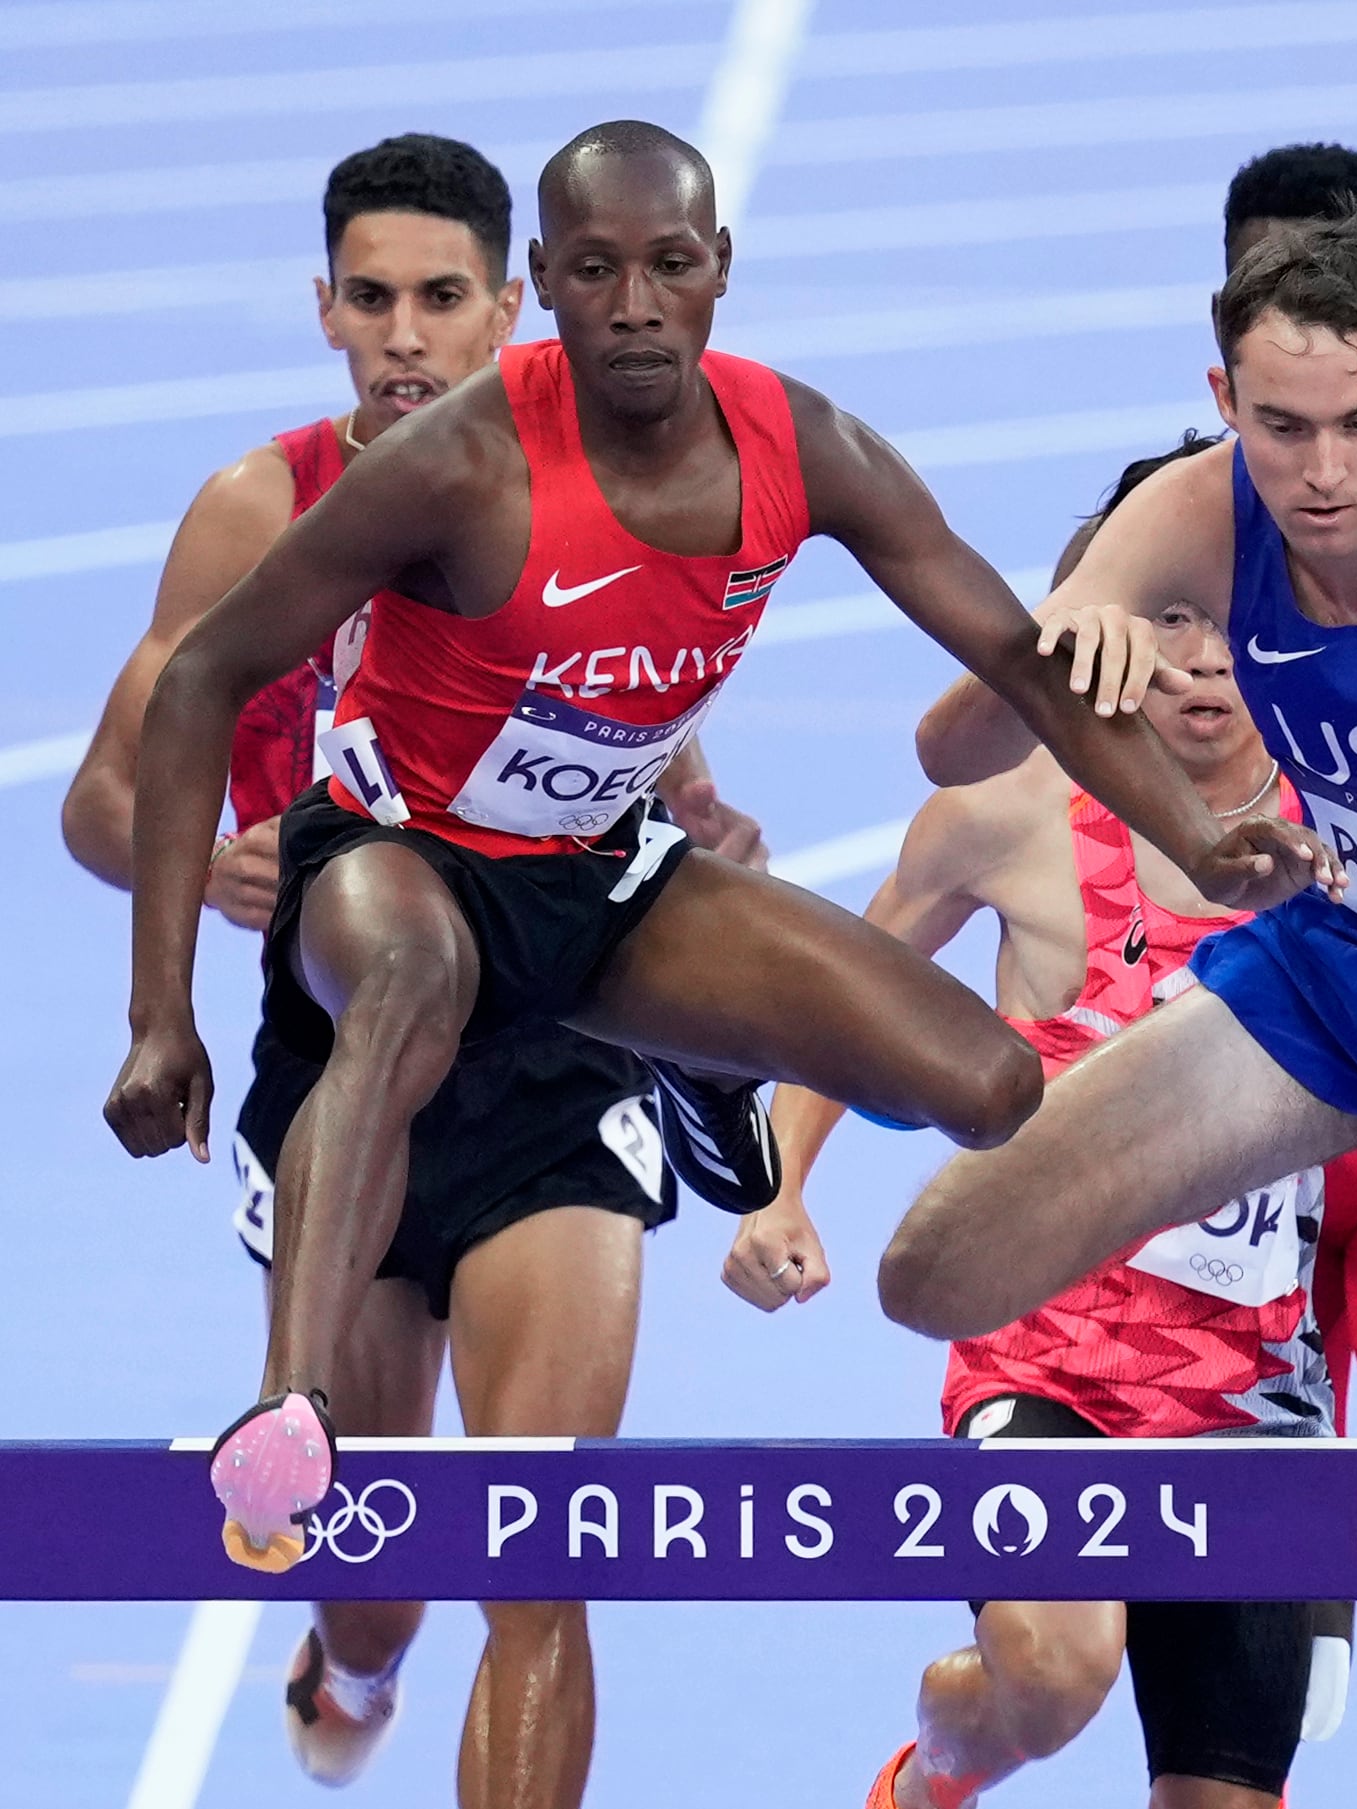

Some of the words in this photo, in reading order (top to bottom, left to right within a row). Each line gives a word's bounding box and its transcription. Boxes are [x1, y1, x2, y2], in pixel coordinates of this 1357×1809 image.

[583, 720, 649, 743] PARIS
[487, 1484, 835, 1560] PARIS
[893, 1483, 1208, 1559] 2024
